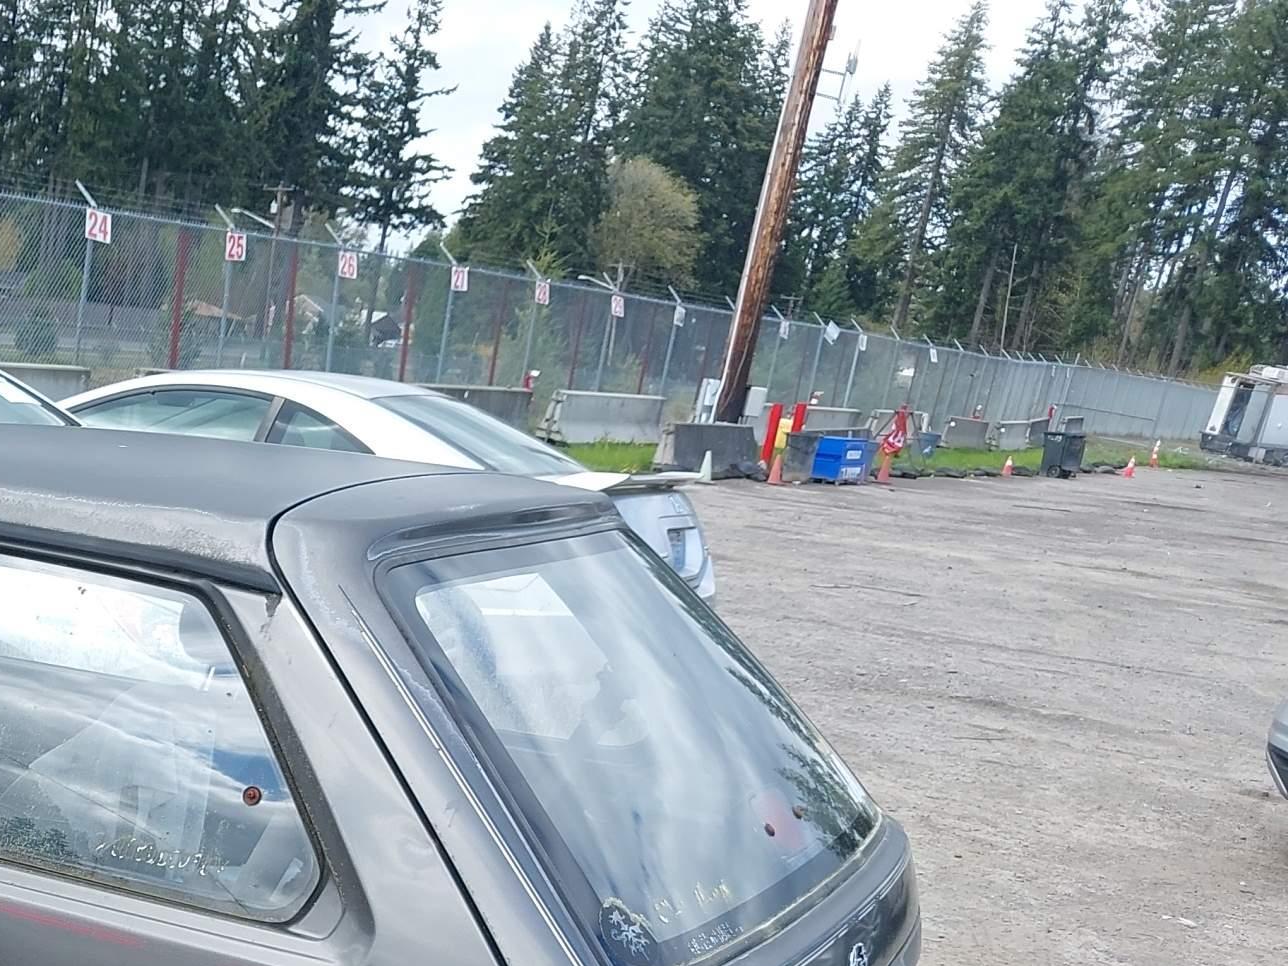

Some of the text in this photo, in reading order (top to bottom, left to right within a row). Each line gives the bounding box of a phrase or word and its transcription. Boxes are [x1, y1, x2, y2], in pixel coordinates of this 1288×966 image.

[87, 210, 109, 239] 24
[228, 234, 244, 260] 25
[341, 254, 355, 277] 26
[453, 270, 465, 289] 27
